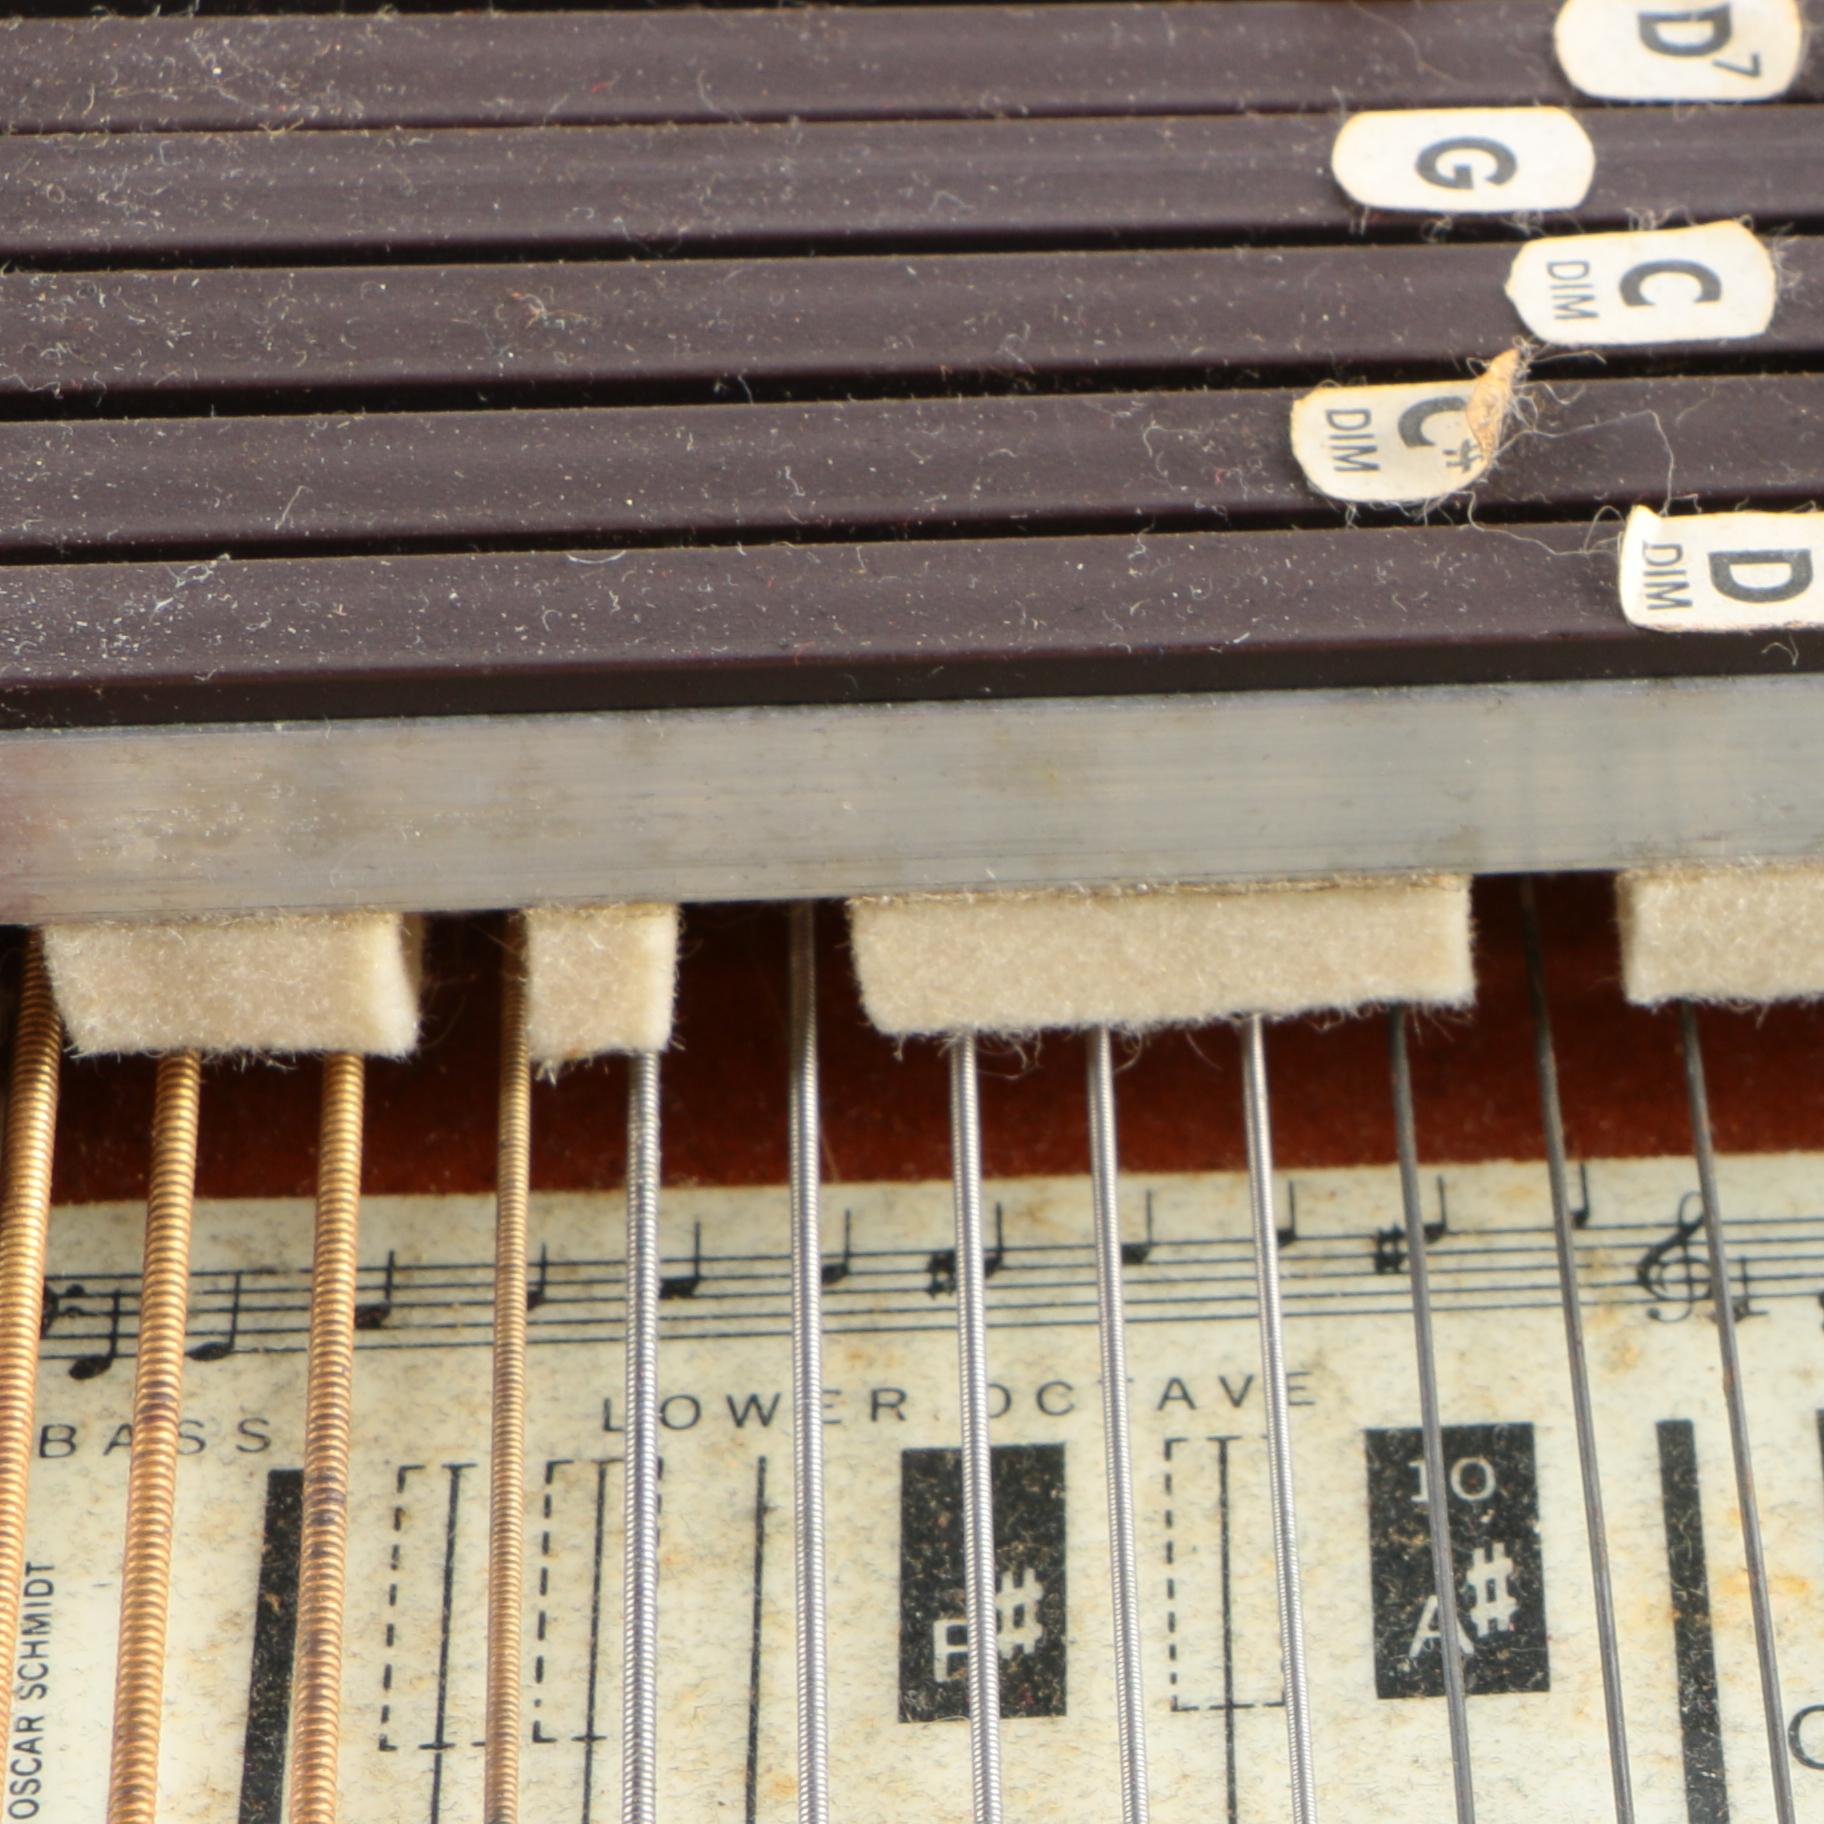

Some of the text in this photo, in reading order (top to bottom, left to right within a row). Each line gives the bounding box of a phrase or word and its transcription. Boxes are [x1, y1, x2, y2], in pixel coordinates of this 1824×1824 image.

[1416, 137, 1518, 190] G
[1546, 261, 1597, 321] DIM
[1619, 260, 1722, 309] C
[1326, 408, 1372, 474] DIM
[1641, 541, 1693, 611] DIM
[1708, 548, 1813, 603] D
[39, 1416, 271, 1459] BASS
[19, 1561, 55, 1700] SCHMIDT
